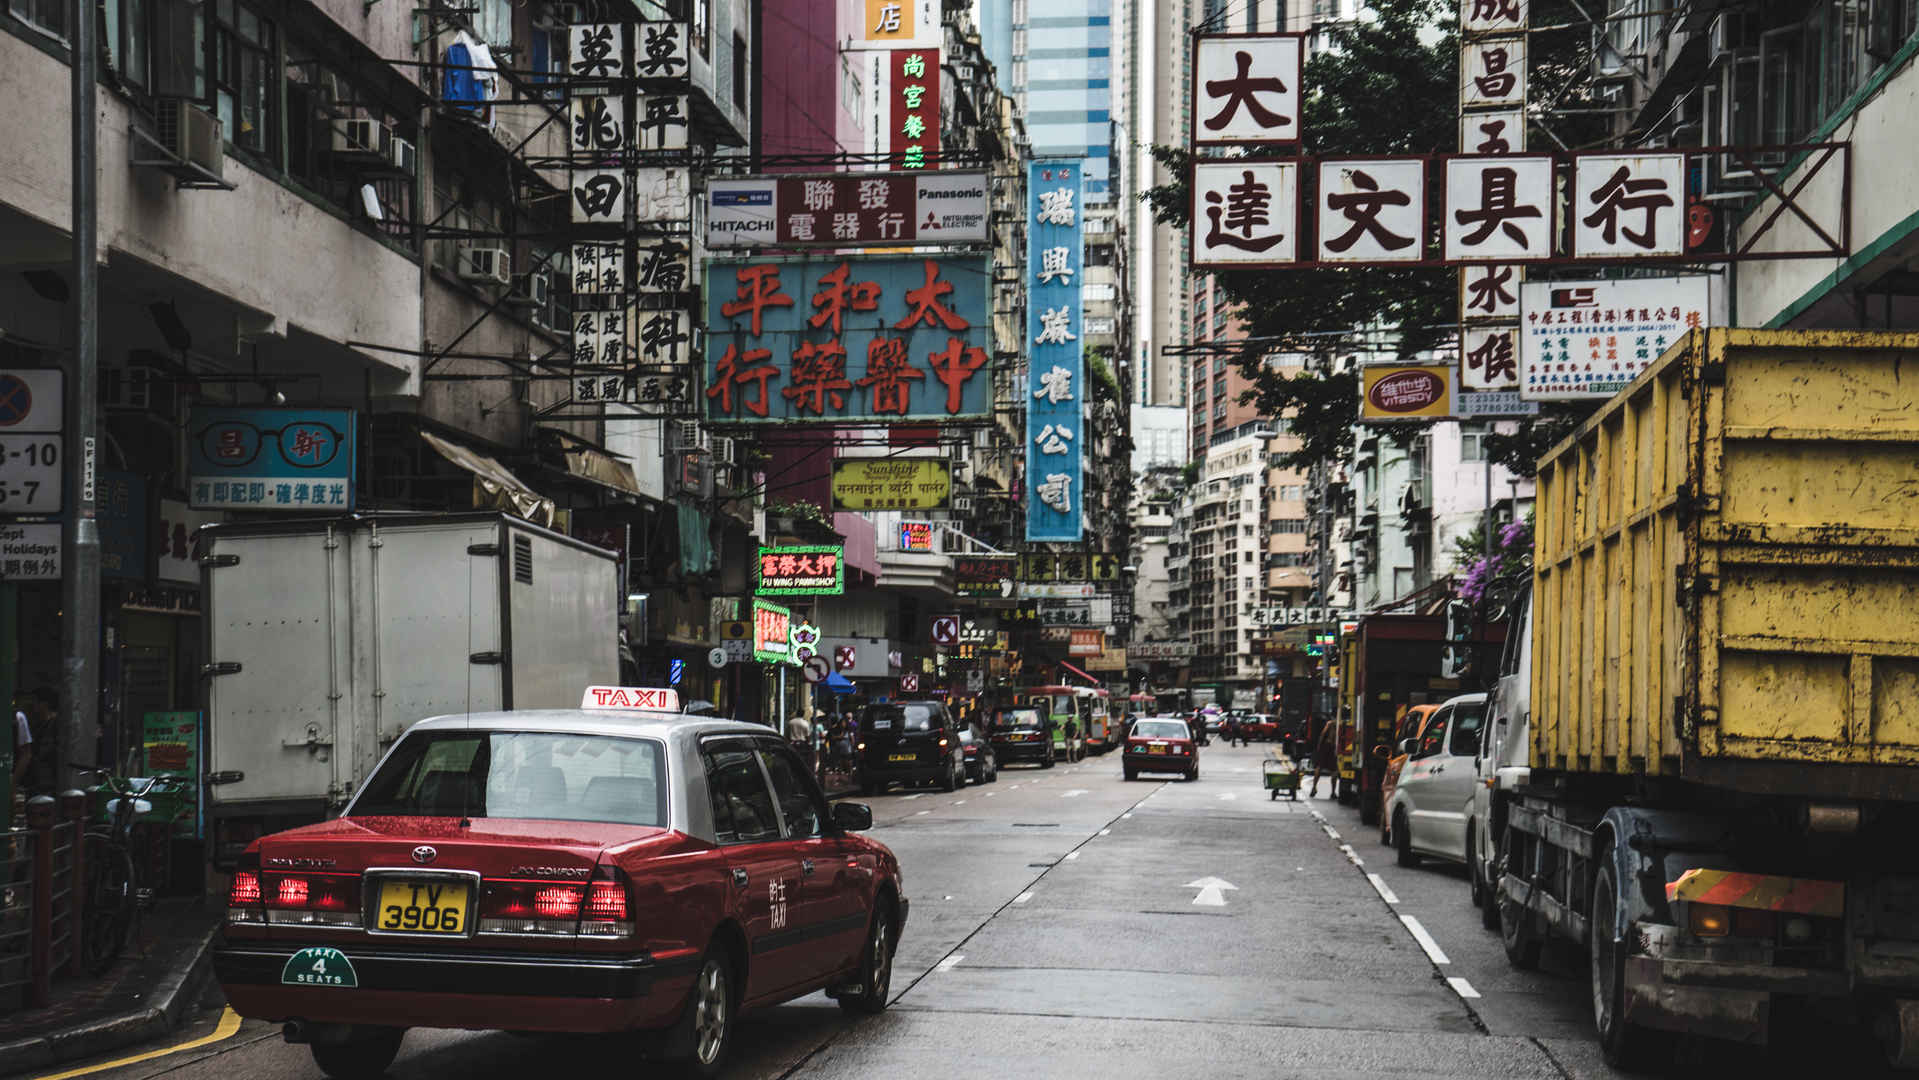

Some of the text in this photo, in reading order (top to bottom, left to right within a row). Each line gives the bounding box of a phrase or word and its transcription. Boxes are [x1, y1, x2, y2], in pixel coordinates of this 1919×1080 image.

[875, 3, 901, 33] 店
[1204, 51, 1292, 130] 大
[804, 179, 890, 211] 聯發
[919, 187, 983, 199] Panasonic
[1205, 166, 1674, 253] 達文具行
[710, 221, 774, 232] HITACHI
[789, 212, 904, 241] 電器行
[1467, 265, 1516, 384] 水喉
[3, 543, 57, 556] Holidays
[762, 578, 772, 587] FU
[773, 578, 793, 587] WING
[592, 688, 668, 708] TAXI
[408, 885, 441, 908] TV
[769, 876, 786, 903] 的士
[385, 905, 459, 931] 3906
[769, 902, 786, 929] TAXI
[306, 948, 337, 960] TAXI
[312, 958, 327, 974] 4
[297, 973, 342, 985] SEATS
